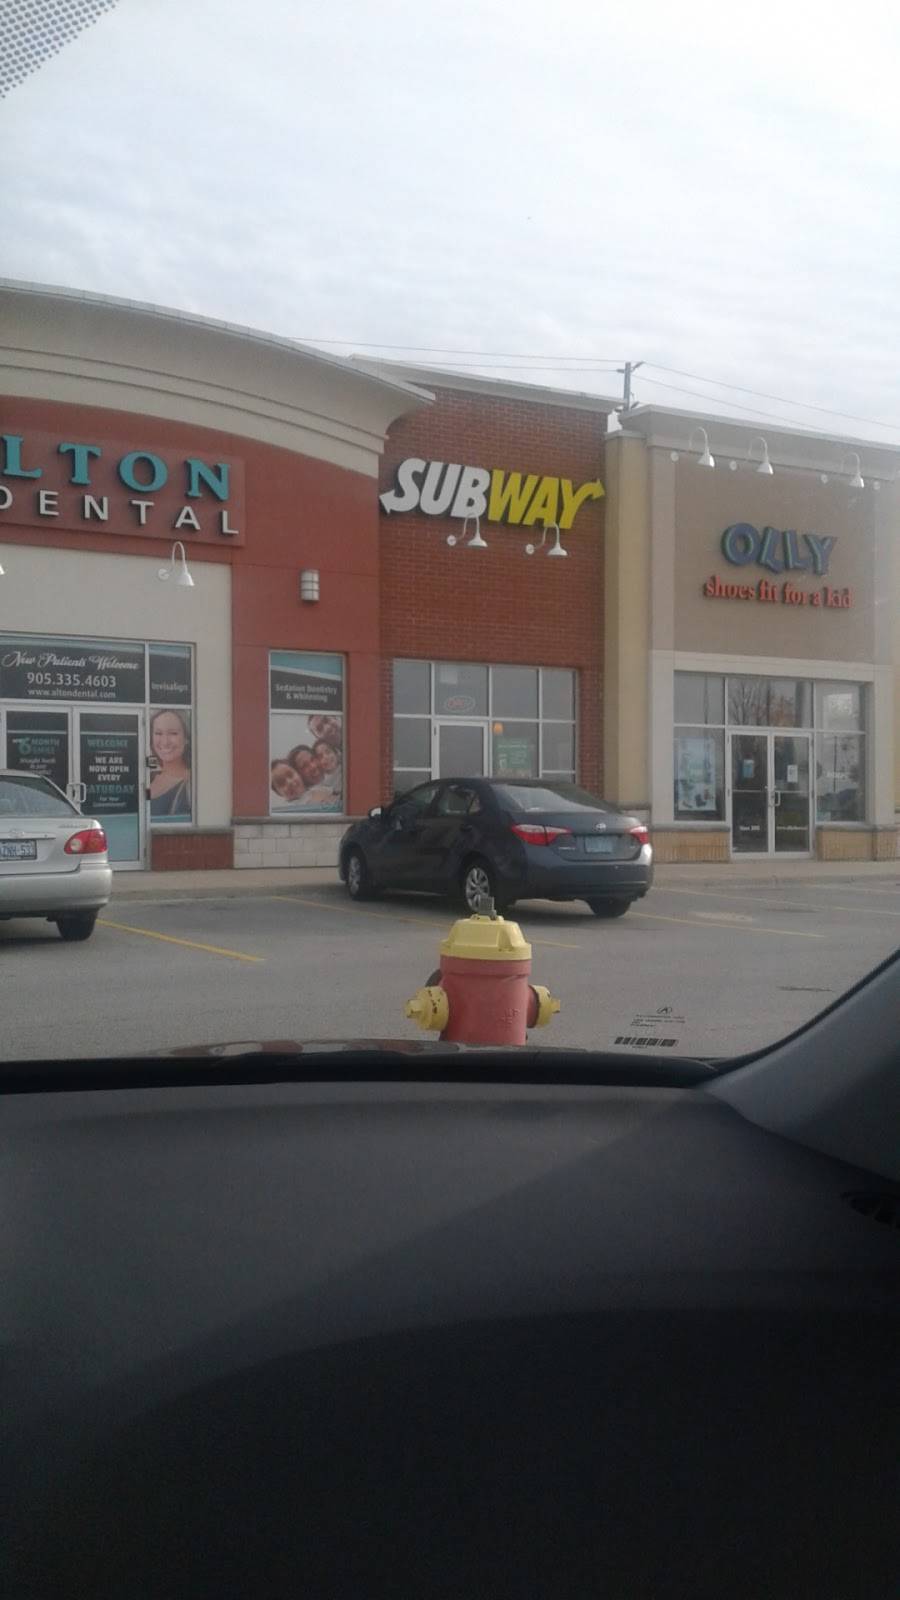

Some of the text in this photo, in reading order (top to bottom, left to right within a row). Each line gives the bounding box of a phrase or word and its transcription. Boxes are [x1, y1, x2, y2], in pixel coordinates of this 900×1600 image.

[379, 458, 605, 530] SUBWAY
[720, 522, 836, 576] OLLY
[704, 574, 854, 609] shoes fit for a kid
[2, 651, 141, 670] New Patients Welcome
[27, 672, 117, 688] 905.335.4603
[28, 687, 117, 699] www.altondental.com
[95, 756, 123, 765] WE ARE
[89, 765, 129, 773] NOW OPEN
[97, 774, 121, 782] EVERY
[85, 784, 135, 794] ATURDAY
